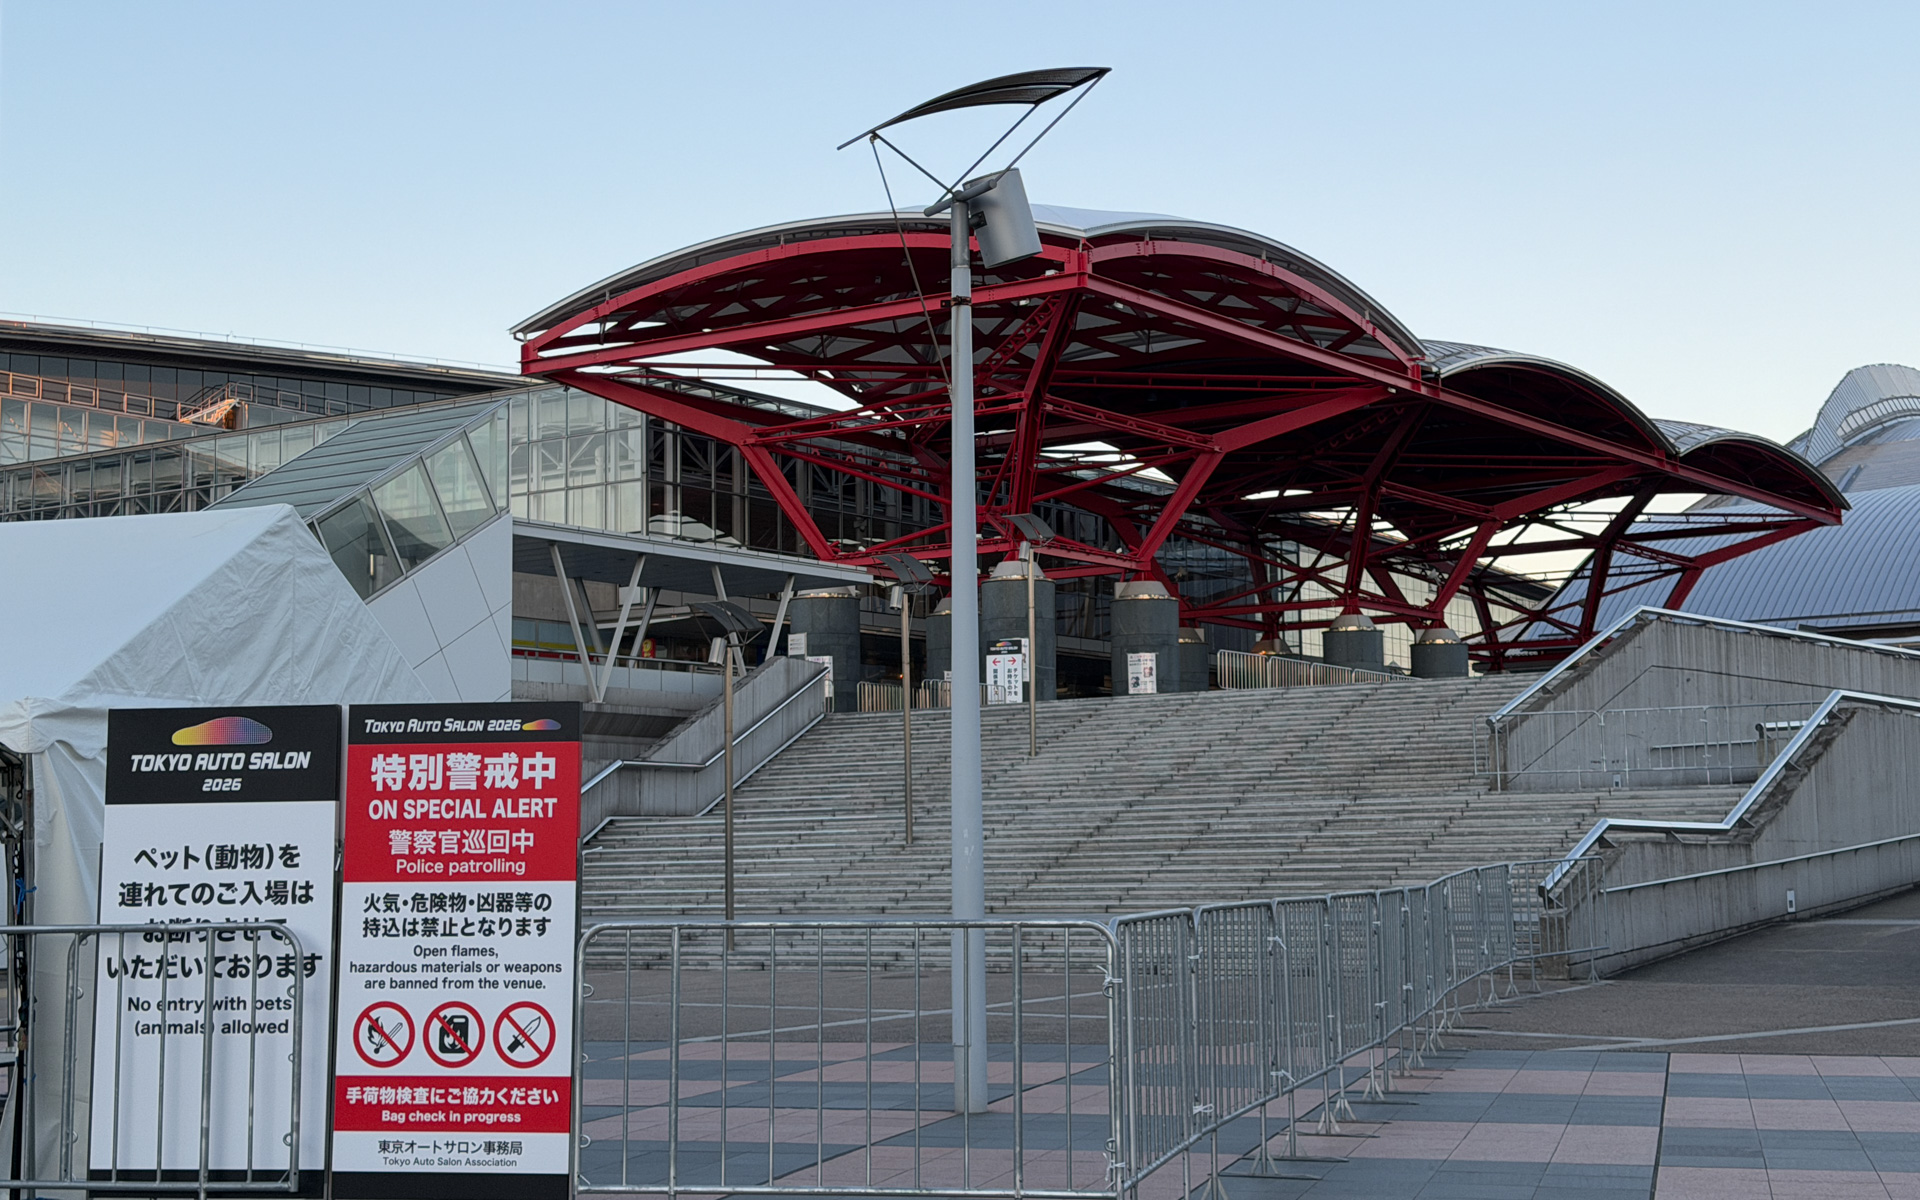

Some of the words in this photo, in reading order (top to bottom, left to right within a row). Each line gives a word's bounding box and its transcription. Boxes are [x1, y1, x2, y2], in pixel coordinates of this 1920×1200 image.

[365, 719, 405, 733] TOKYO
[407, 718, 441, 733] AUTO
[443, 718, 485, 732] SALON
[487, 719, 522, 731] 2026
[130, 754, 192, 772] TOKYO
[194, 752, 246, 771] AUTO
[249, 751, 311, 770] SALON
[370, 752, 556, 791] 特別警戒中
[202, 778, 242, 791] 2026
[368, 799, 398, 820] ON
[403, 798, 486, 819] SPECIAL
[492, 798, 558, 818] ALERT
[389, 828, 534, 855] 警察官巡回中
[134, 843, 300, 870] ペット(動物)を
[396, 859, 444, 874] Police
[449, 858, 526, 876] patrolling
[118, 880, 314, 907] 連れてのご入場は
[363, 892, 552, 914] 火気・危険物・凶器等の
[362, 917, 551, 938] 持込は禁止となります
[413, 944, 447, 959] Open
[451, 944, 499, 958] flames,
[106, 953, 323, 979] いただいております
[350, 961, 417, 973] hazardous
[421, 961, 482, 973] materials
[486, 963, 500, 973] or
[504, 963, 562, 975] weapons
[364, 980, 386, 989] are
[390, 977, 438, 989] banned
[442, 977, 474, 989] from
[478, 977, 499, 989] the
[503, 979, 546, 989] venue.
[128, 997, 151, 1011] No
[156, 998, 204, 1014] entry
[212, 996, 247, 1011] with
[135, 1020, 214, 1036] (anmals
[221, 1019, 289, 1034] allowed
[345, 1086, 559, 1106] 手荷物検査にご協力ください
[382, 1110, 405, 1123] Bag
[408, 1110, 445, 1122] check
[449, 1111, 460, 1122] in
[464, 1112, 521, 1124] progress
[378, 1139, 523, 1155] 東京オートサロン事務局
[383, 1157, 411, 1167] Tokyo
[413, 1157, 435, 1166] Auto
[437, 1157, 462, 1166] Salon
[465, 1158, 517, 1167] Association
